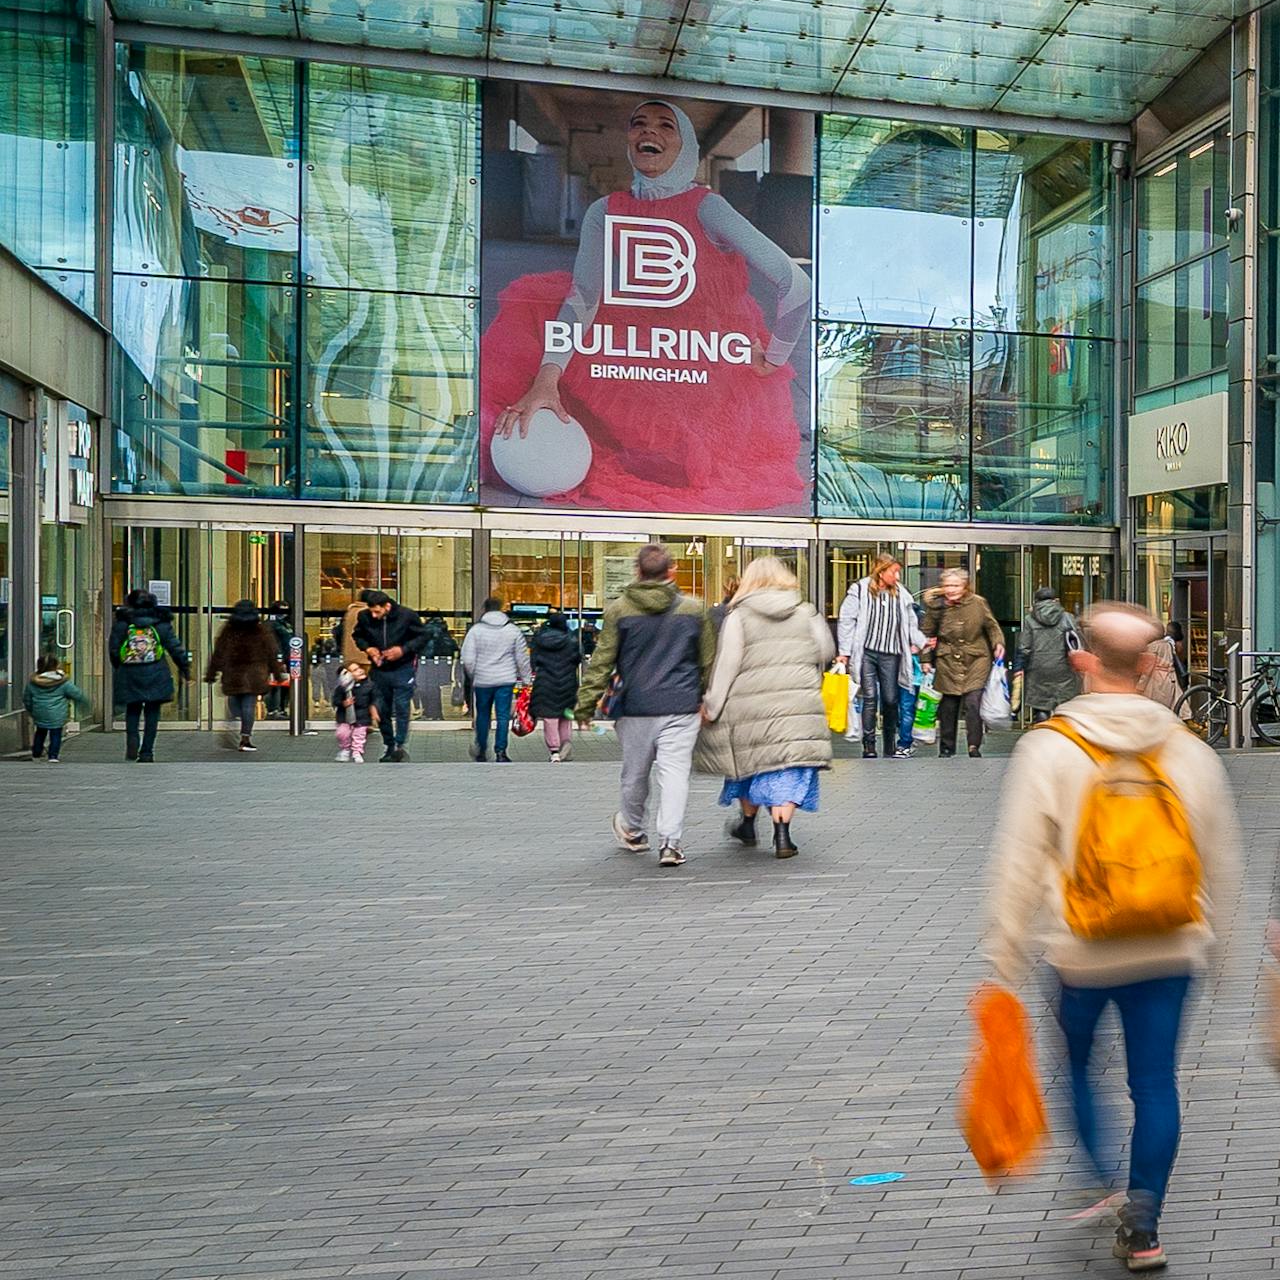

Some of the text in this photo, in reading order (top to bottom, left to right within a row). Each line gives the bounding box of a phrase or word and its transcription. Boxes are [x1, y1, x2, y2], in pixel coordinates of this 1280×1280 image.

[544, 320, 752, 364] BULLRING
[590, 363, 708, 384] BIRMINGHAM
[1156, 422, 1190, 459] KIKO
